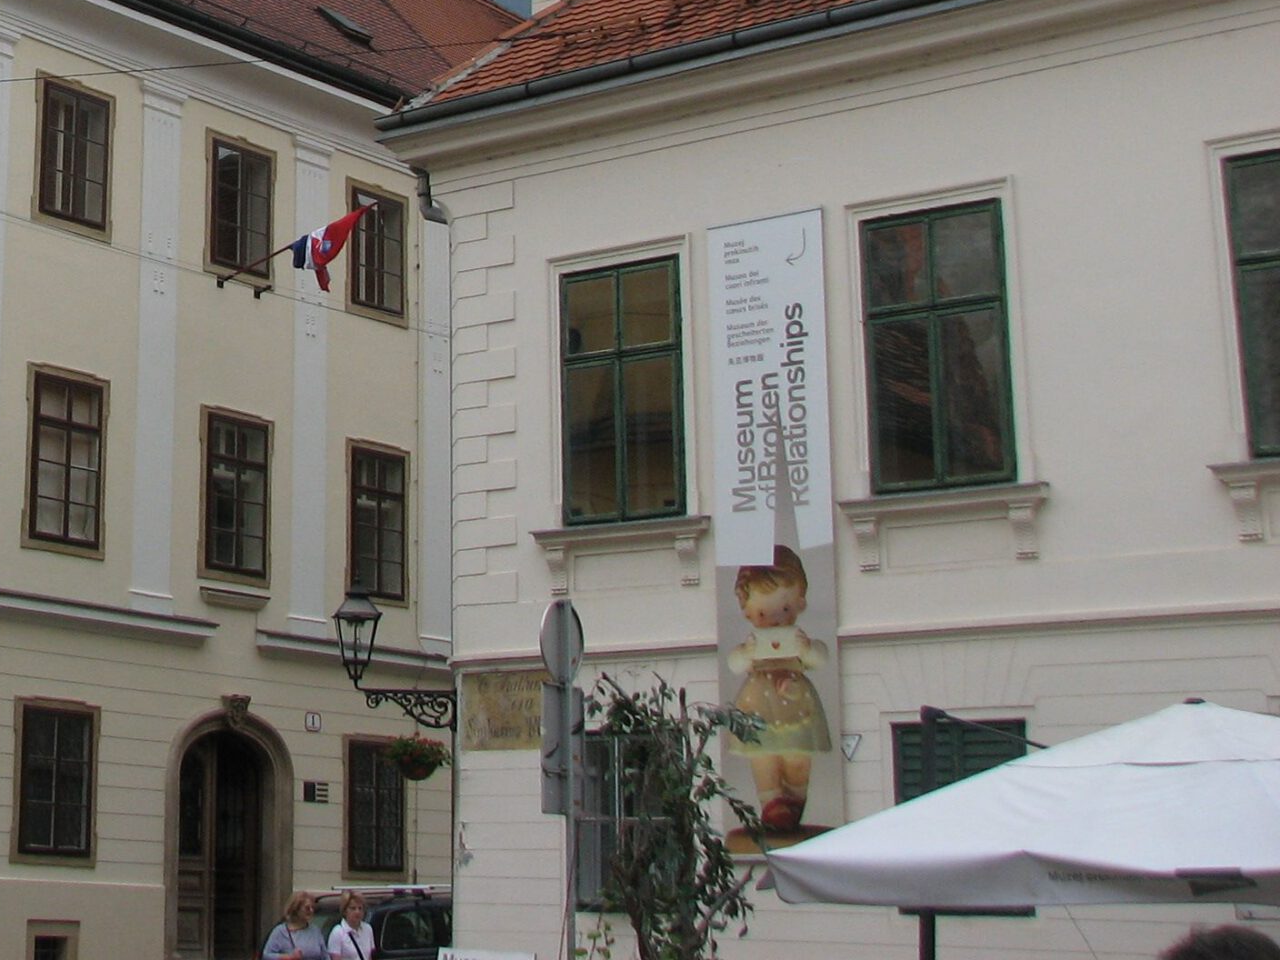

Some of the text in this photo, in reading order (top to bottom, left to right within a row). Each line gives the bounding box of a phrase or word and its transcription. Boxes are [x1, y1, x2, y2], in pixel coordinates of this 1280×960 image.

[732, 379, 756, 512] Museum
[757, 372, 779, 481] Broken
[780, 302, 809, 506] Relationships
